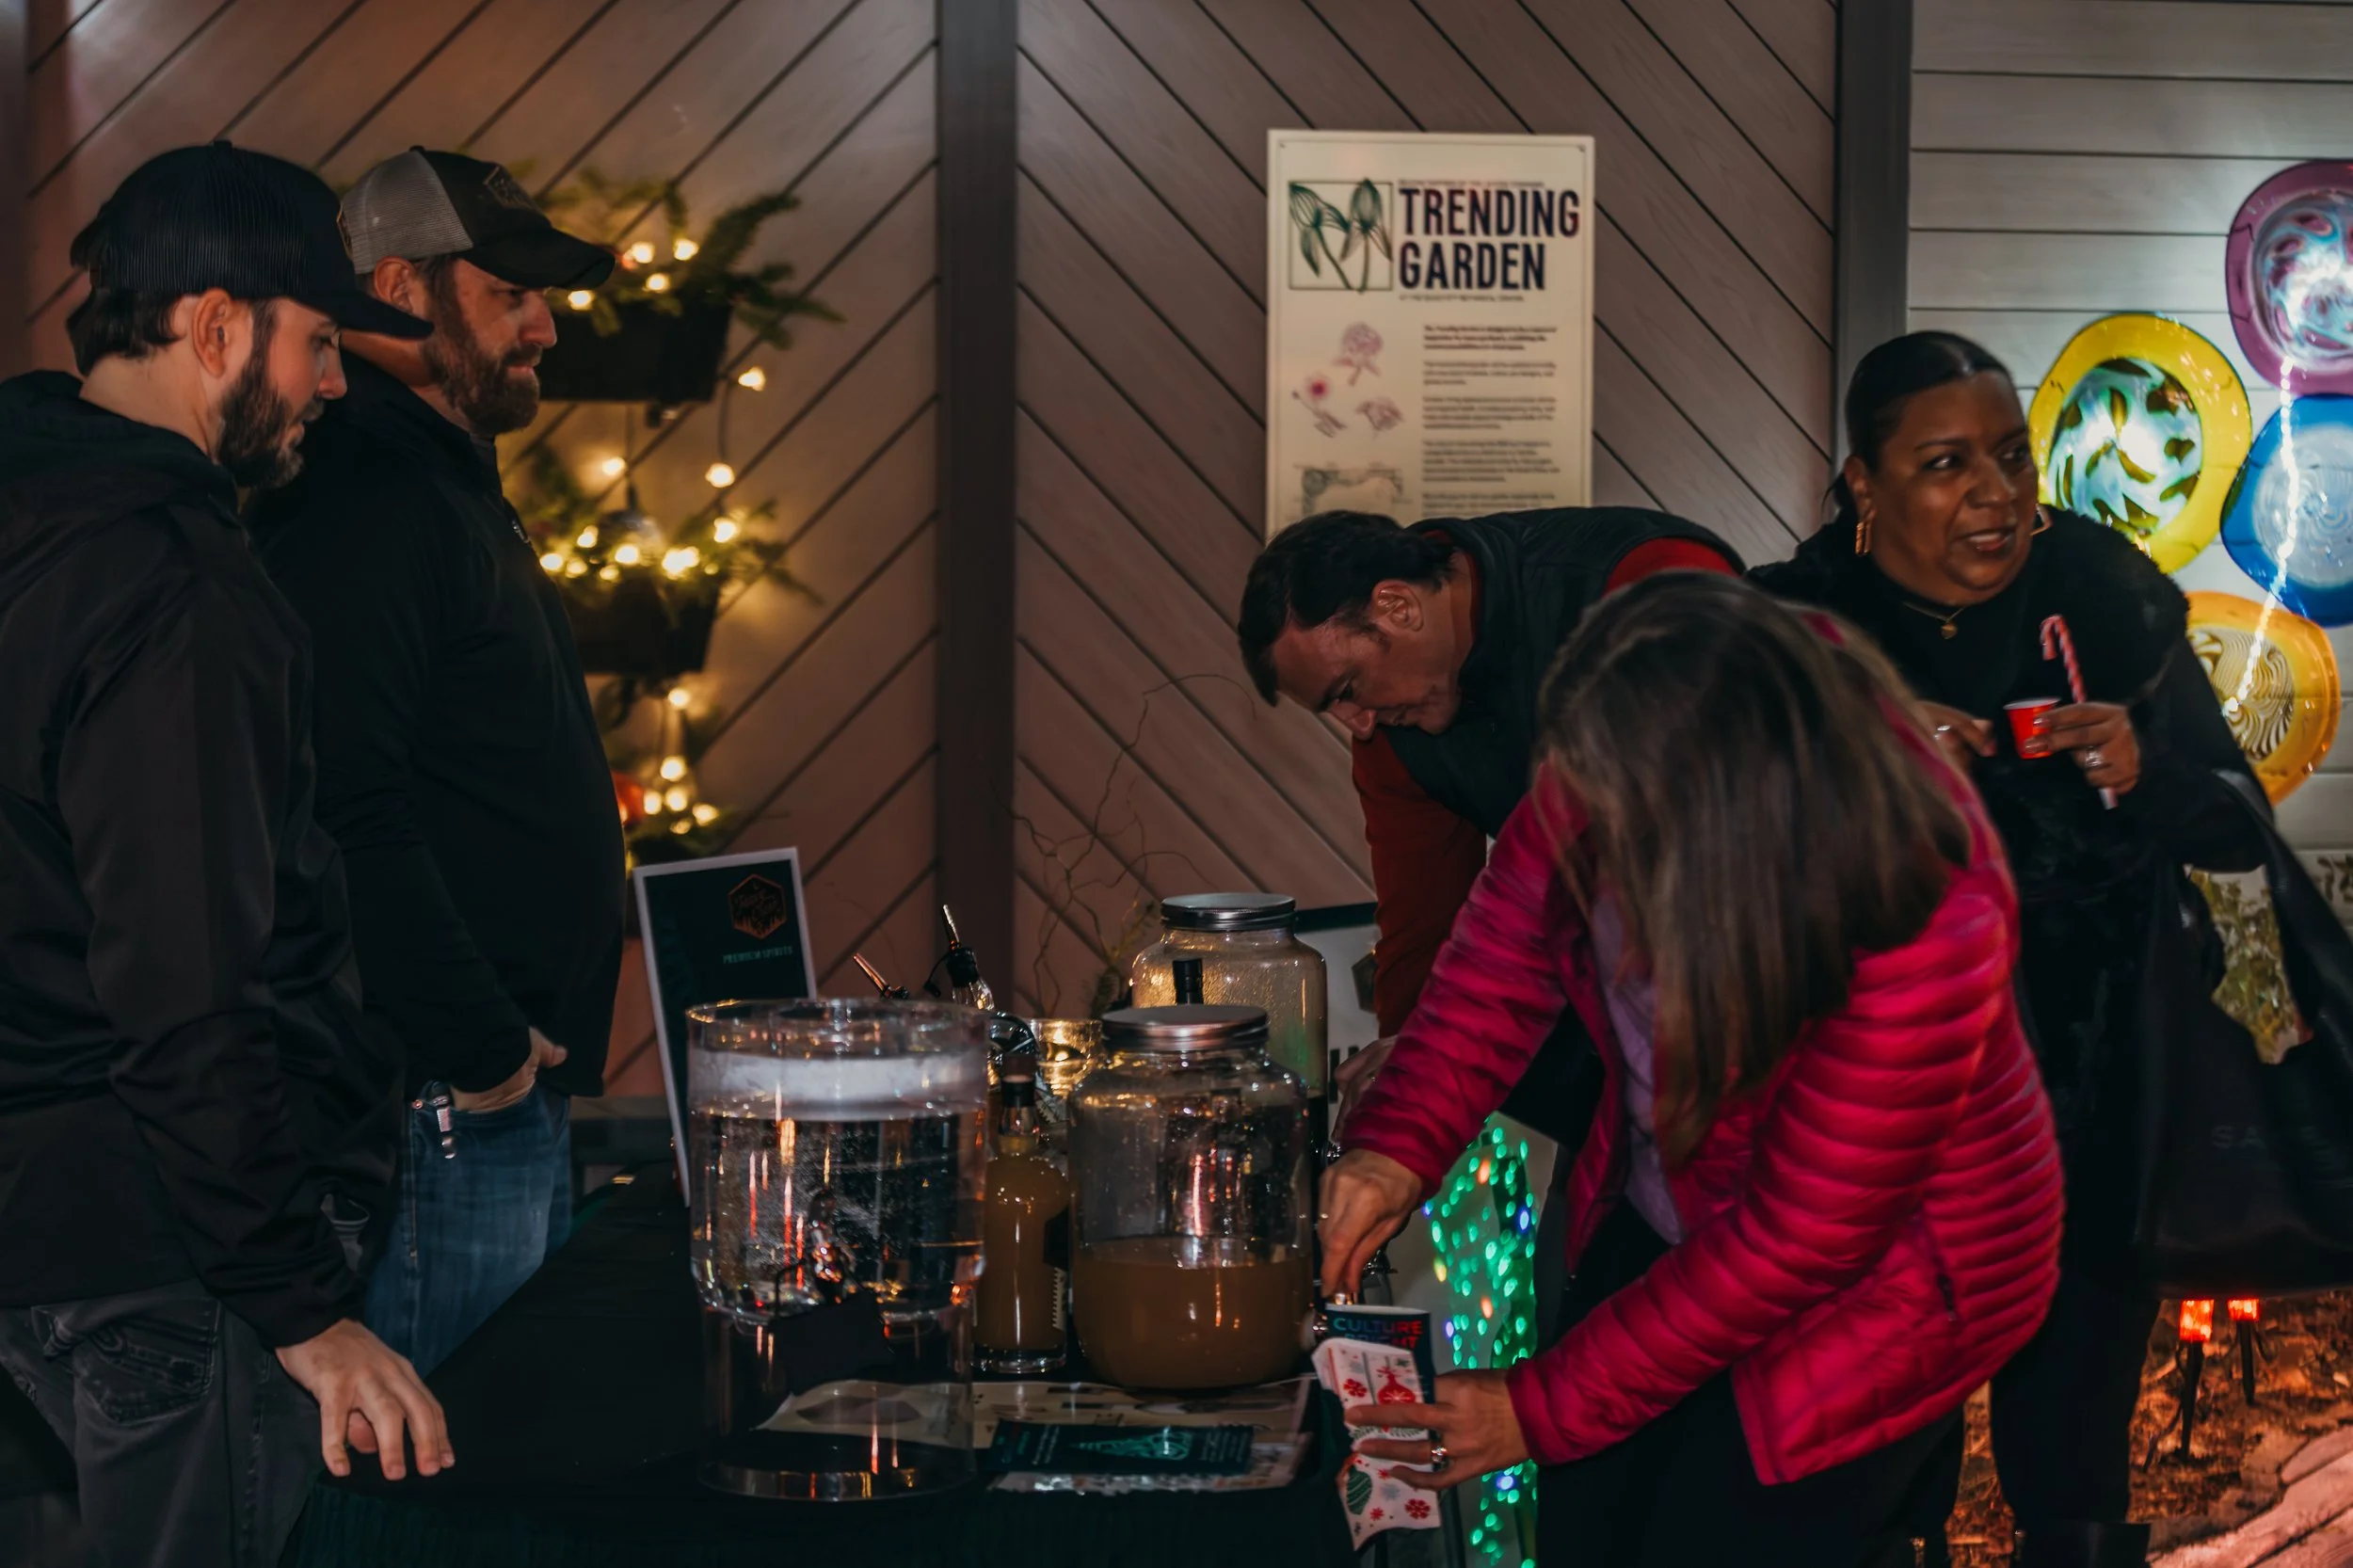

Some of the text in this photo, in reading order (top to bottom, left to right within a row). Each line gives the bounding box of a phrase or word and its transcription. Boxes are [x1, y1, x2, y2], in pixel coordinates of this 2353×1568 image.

[1399, 188, 1579, 236] TRENDING
[1400, 241, 1545, 290] GARDEN
[1333, 1317, 1423, 1335] CULTURE
